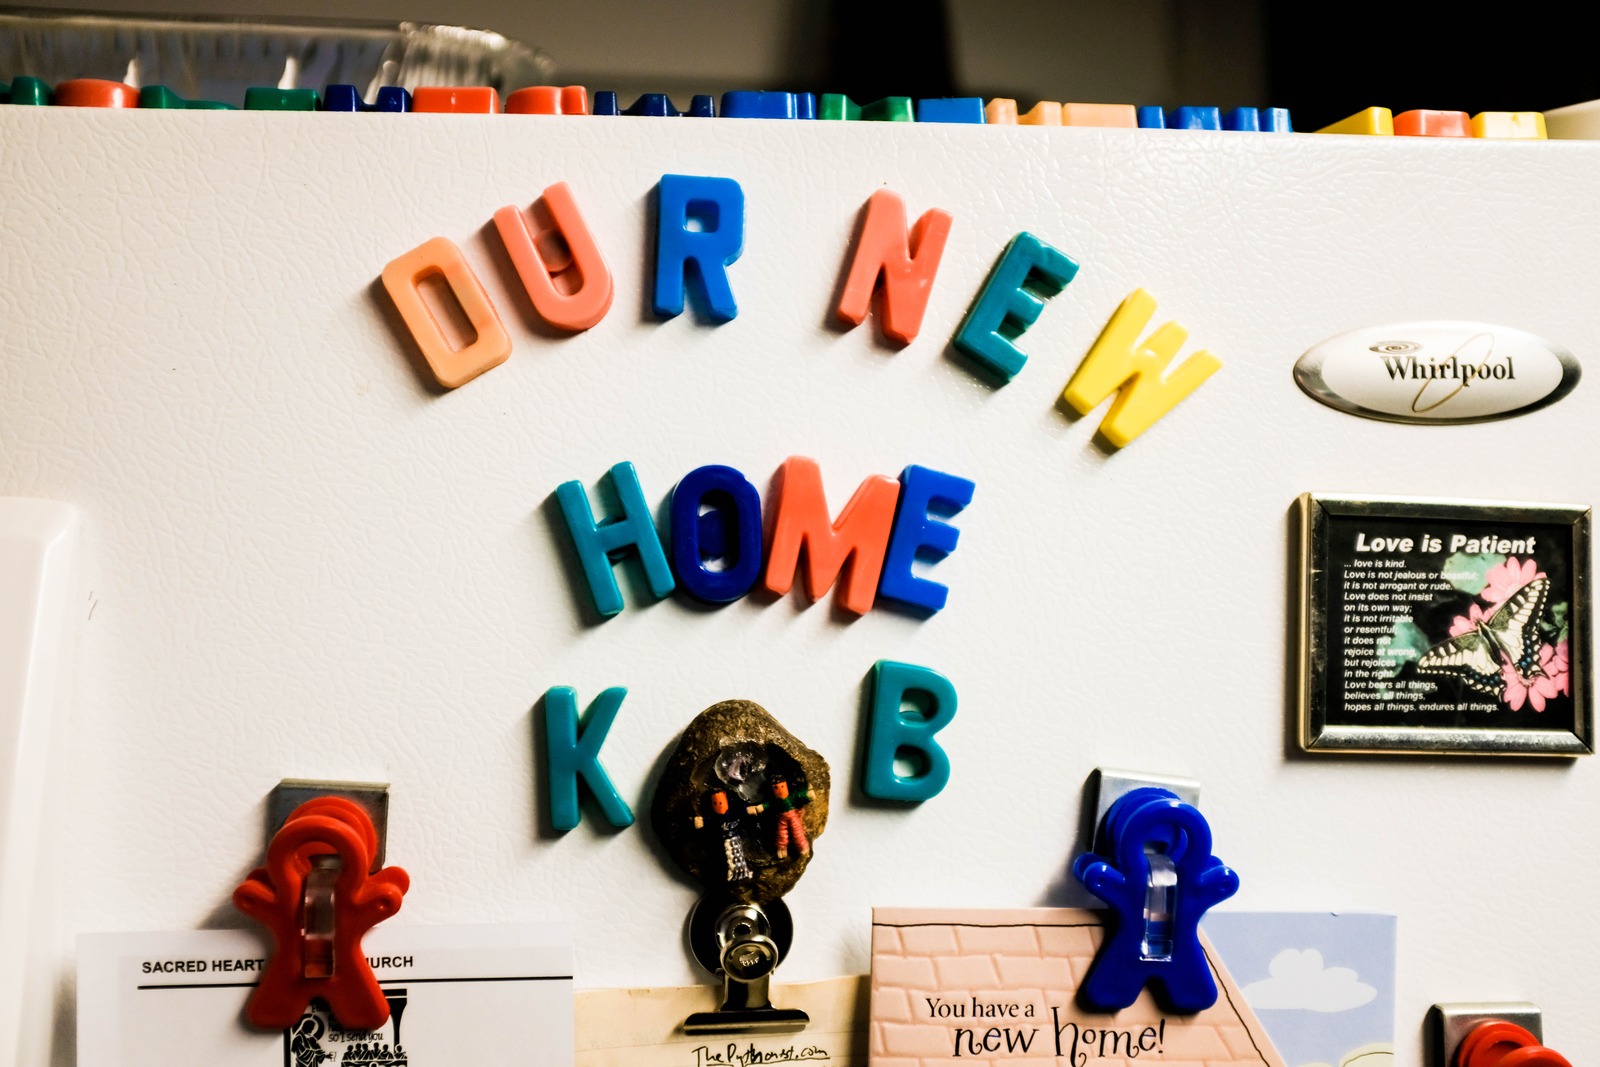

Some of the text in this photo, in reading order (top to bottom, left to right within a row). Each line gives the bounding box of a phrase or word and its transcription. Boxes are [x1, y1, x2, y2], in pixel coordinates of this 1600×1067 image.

[382, 174, 1222, 449] OUR NEW
[1380, 356, 1516, 387] Whirlpool
[556, 454, 975, 615] HOME
[1356, 533, 1536, 554] Love is Patient
[1354, 559, 1373, 568] love
[1375, 559, 1383, 568] is
[1385, 559, 1406, 568] kind.
[1344, 570, 1366, 579] Love
[1367, 571, 1376, 579] is
[1378, 571, 1393, 579] not
[1394, 571, 1427, 581] jealous
[1344, 582, 1350, 590] it
[1351, 582, 1361, 590] is
[1379, 582, 1417, 592] arrogant
[1430, 582, 1453, 591] rude.
[1344, 592, 1366, 600] Love
[1367, 592, 1389, 600] does
[1408, 592, 1433, 601] insist
[1358, 603, 1369, 611] its
[1392, 604, 1413, 614] way;
[1344, 614, 1413, 623] it is not irritable
[1344, 636, 1392, 645] it does not
[1344, 648, 1374, 657] rejoice
[1376, 648, 1385, 656] at
[1344, 659, 1396, 668] but rejoices
[1345, 681, 1438, 691] Love bears all things,
[1344, 692, 1380, 700] believes
[1382, 692, 1394, 700] all
[1344, 703, 1371, 712] hopes
[1374, 703, 1384, 711] all
[1419, 703, 1455, 711] endures
[1457, 703, 1468, 711] all
[1470, 703, 1499, 713] things.
[545, 659, 957, 830] K B
[141, 960, 207, 974] SACRED
[212, 958, 265, 973] HEART
[925, 997, 1035, 1018] You have a
[328, 1034, 338, 1042] so
[368, 1032, 383, 1043] you
[952, 1006, 1166, 1067] new home!
